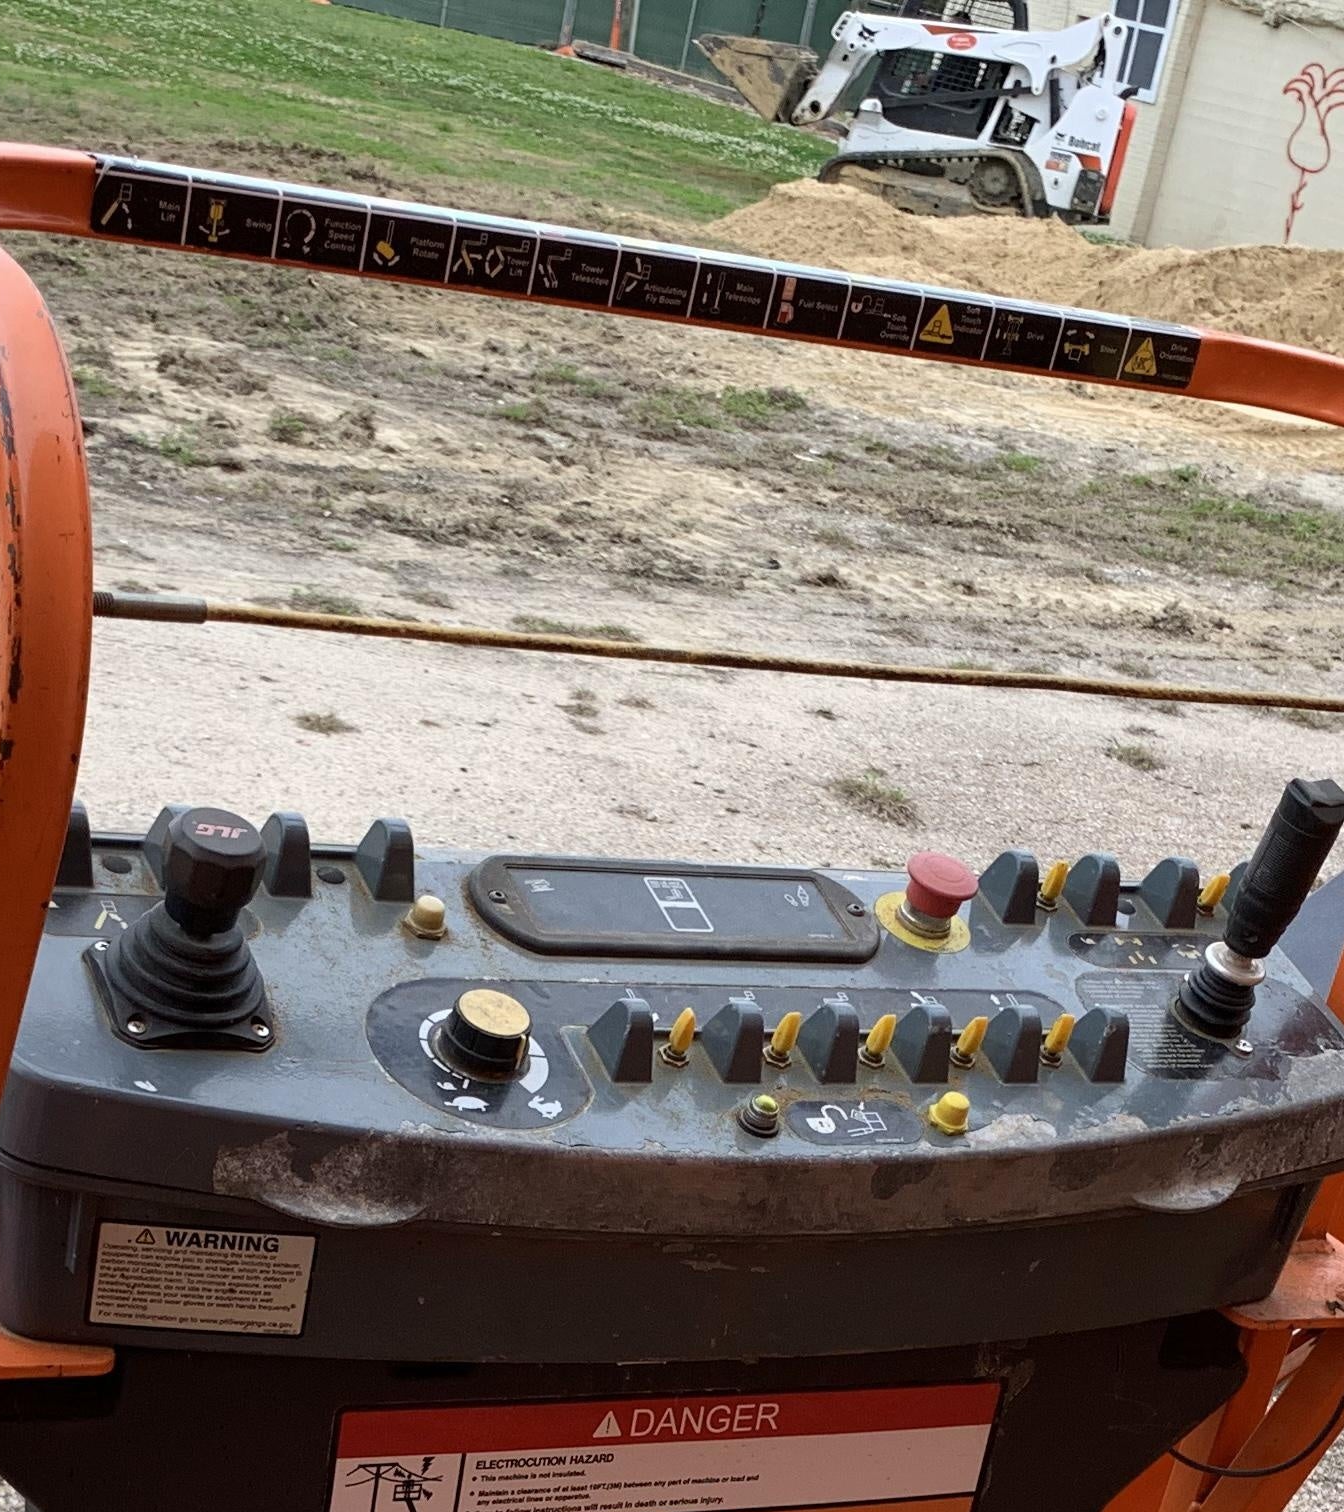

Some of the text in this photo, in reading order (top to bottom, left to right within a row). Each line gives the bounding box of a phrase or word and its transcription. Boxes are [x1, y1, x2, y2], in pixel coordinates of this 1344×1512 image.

[1069, 136, 1101, 152] Bobcat
[195, 823, 248, 839] JLG
[164, 1230, 280, 1252] WARNING
[629, 1402, 782, 1437] DANGER
[474, 1452, 615, 1470] ELECTROCUTION HAZARD
